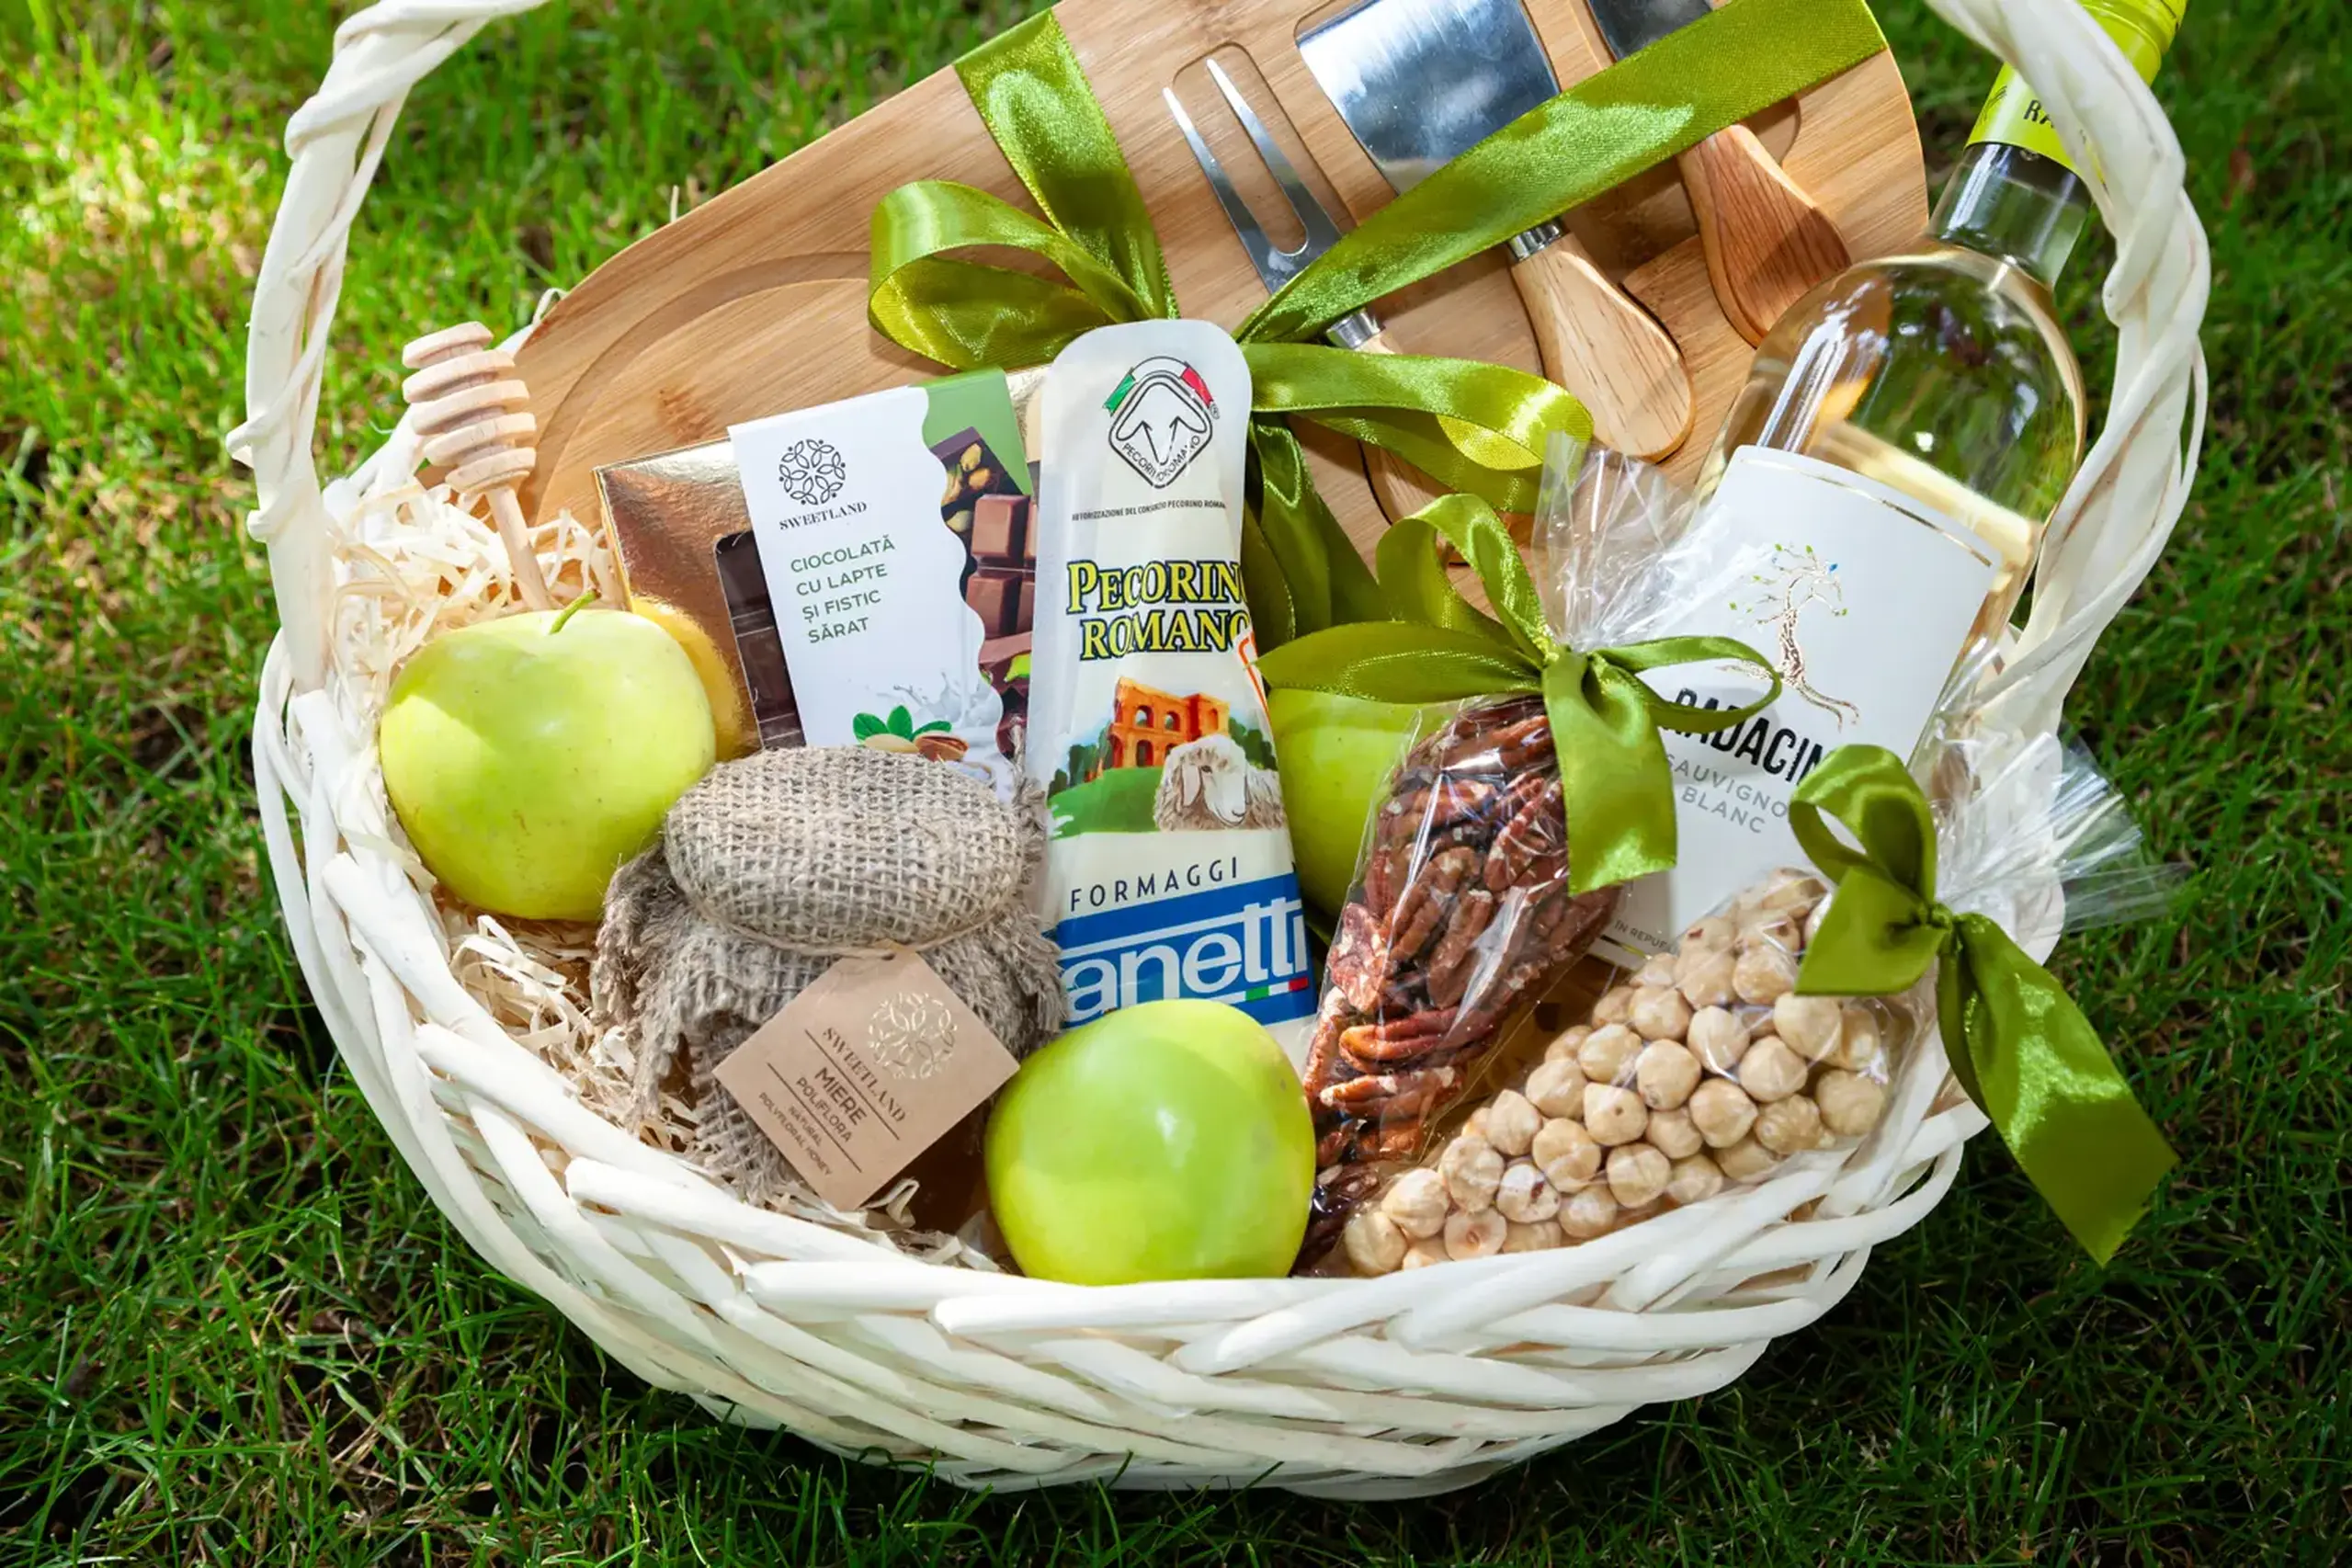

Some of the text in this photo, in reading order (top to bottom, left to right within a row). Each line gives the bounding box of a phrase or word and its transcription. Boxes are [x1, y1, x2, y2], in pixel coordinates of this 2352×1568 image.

[779, 502, 867, 530] SWEETLAND
[1125, 507, 1137, 516] DEL
[1167, 499, 1203, 508] PECORINO
[790, 534, 895, 573] CIOCOLATĂ
[796, 562, 889, 597] CU LAPTE
[801, 589, 882, 625] ȘI FISTIC
[808, 616, 869, 644] SĂRAT
[1680, 785, 1767, 835] BLANC
[1070, 856, 1239, 912] FORMAGGI
[1059, 895, 1308, 1023] anetti
[814, 1067, 868, 1126] MIERE
[823, 1028, 906, 1123] SWEETLAND
[796, 1076, 853, 1143] POLIFLORA
